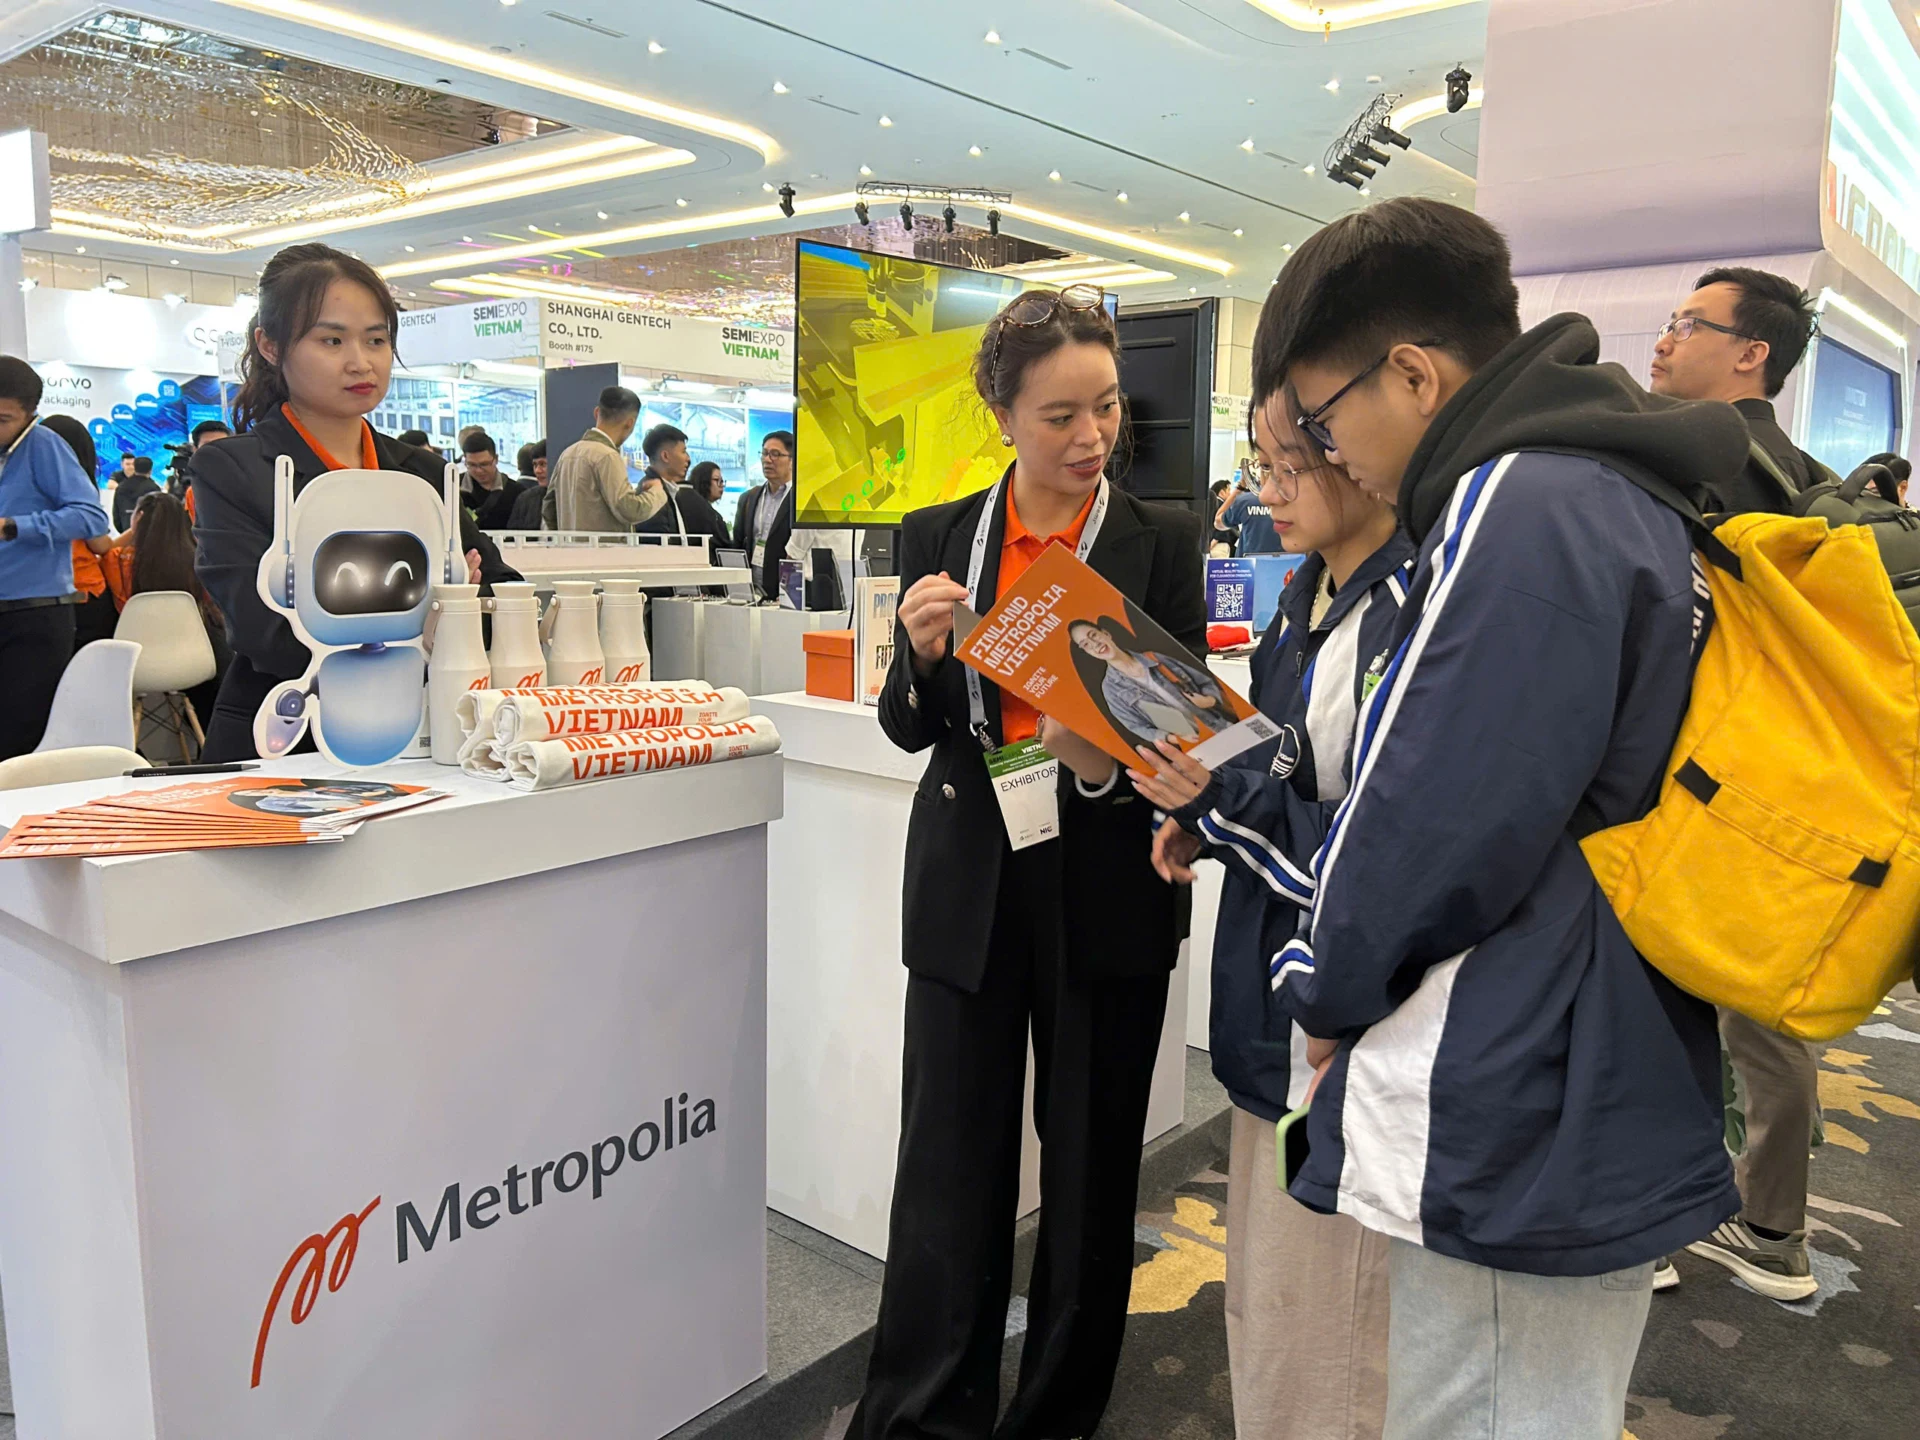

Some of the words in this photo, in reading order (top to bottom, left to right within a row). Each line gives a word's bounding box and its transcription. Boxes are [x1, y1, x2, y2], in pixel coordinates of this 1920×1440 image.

[400, 313, 437, 328] GENTECH
[473, 301, 528, 321] SEMIEXPO
[547, 302, 614, 322] SHANGHAI
[617, 312, 672, 330] GENTECH
[474, 319, 523, 338] VIETNAM
[548, 322, 574, 338] CO.,
[577, 326, 603, 340] LTD.
[721, 326, 785, 348] SEMIEXPO
[548, 341, 574, 352] Booth
[575, 343, 594, 354] #175
[721, 342, 779, 361] VIETNAM
[43, 376, 92, 390] orvo
[44, 394, 91, 408] ackaging
[1212, 405, 1230, 417] TNAM
[873, 592, 899, 619] PRO
[969, 596, 1029, 660] FINLAND
[983, 583, 1068, 669] METROPOLIA
[997, 612, 1062, 677] VIETNAM
[875, 644, 895, 670] FUT
[1023, 666, 1047, 691] IGNITE
[1029, 675, 1047, 695] YOUR
[1035, 674, 1059, 699] FUTURE
[538, 689, 724, 707] METROPOLIA
[543, 707, 683, 734] VIETNAM
[561, 721, 756, 752] METROPOLIA
[1022, 743, 1044, 755] VIETN
[572, 743, 712, 781] VIETNAM
[1000, 766, 1058, 792] EXHIBITOR
[1040, 825, 1053, 835] NIC
[396, 1092, 716, 1263] Metropolia
